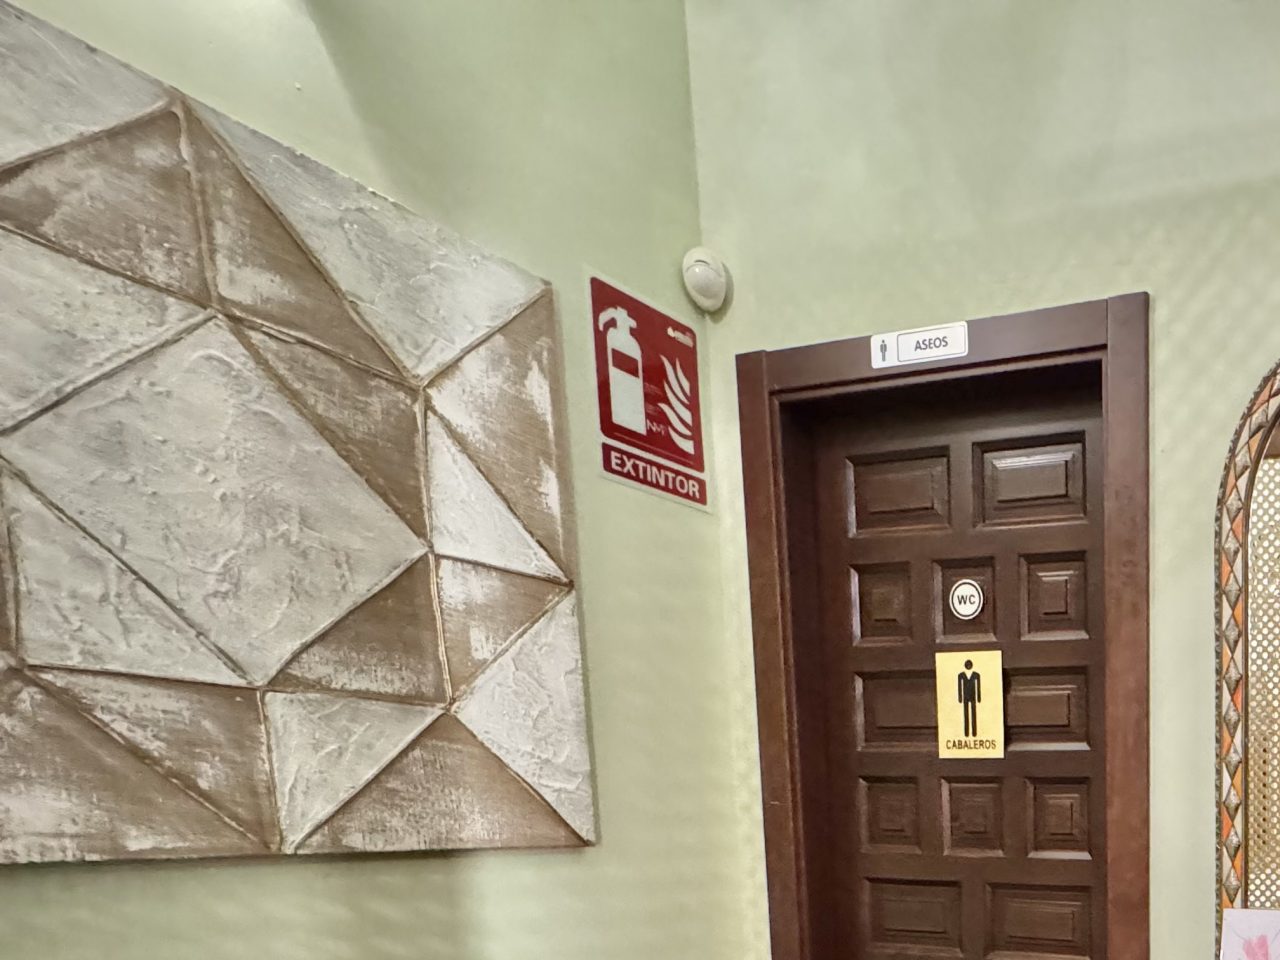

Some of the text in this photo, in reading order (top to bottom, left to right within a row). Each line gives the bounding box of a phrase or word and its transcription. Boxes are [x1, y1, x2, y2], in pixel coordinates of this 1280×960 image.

[914, 336, 949, 352] ASEOS
[610, 450, 700, 499] EXTINTOR
[957, 594, 976, 606] WC
[945, 739, 997, 750] CABALEROS
